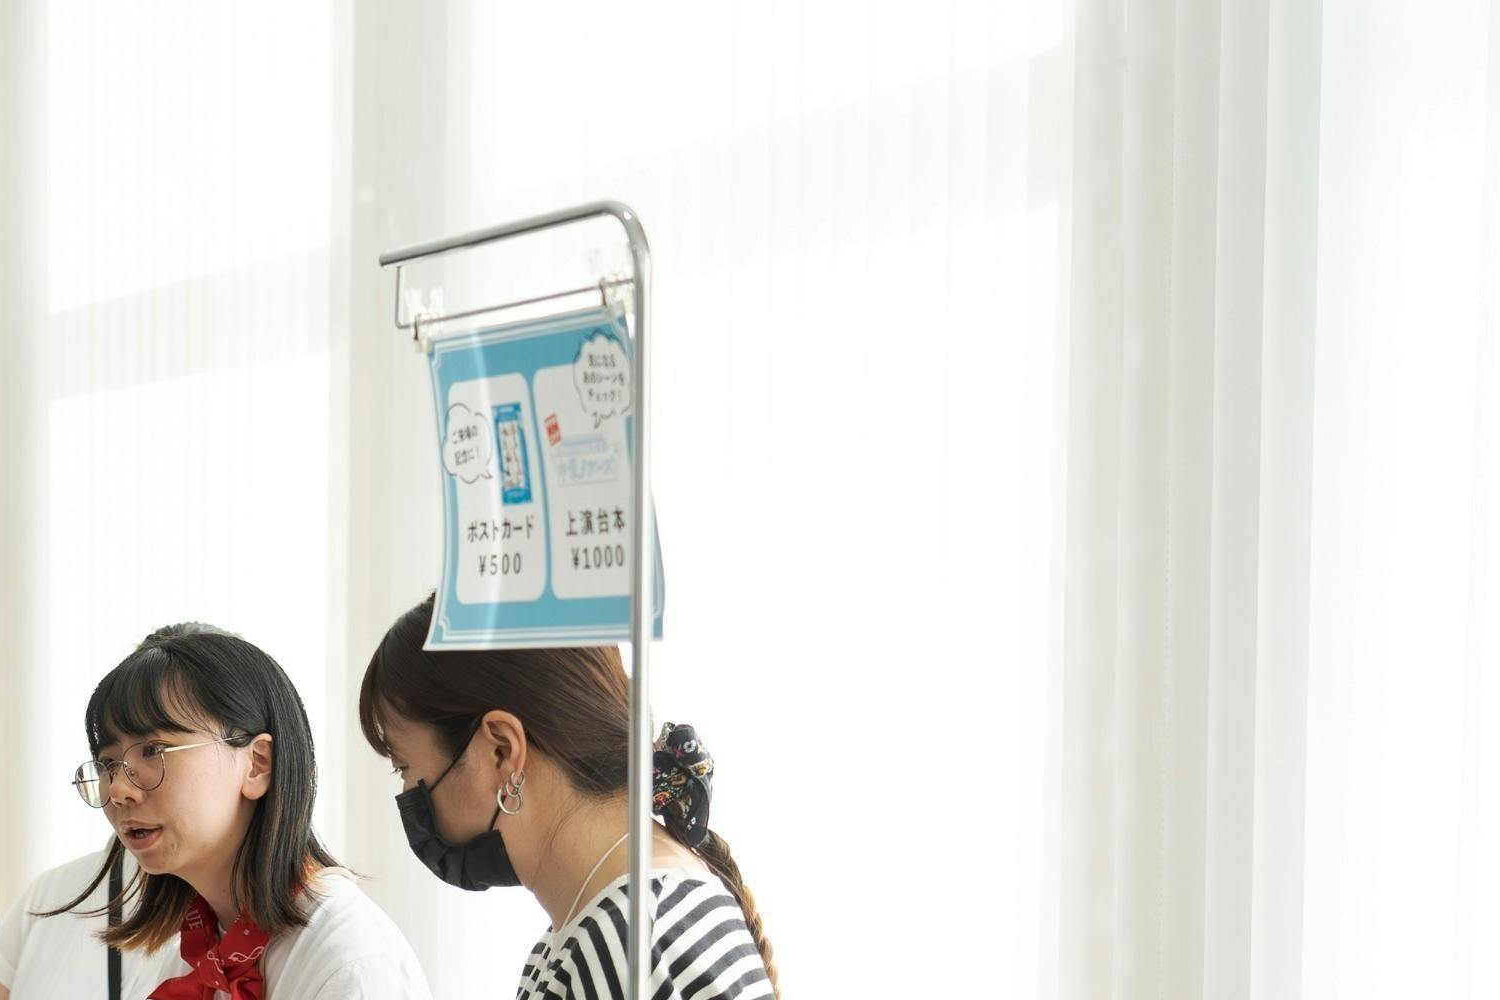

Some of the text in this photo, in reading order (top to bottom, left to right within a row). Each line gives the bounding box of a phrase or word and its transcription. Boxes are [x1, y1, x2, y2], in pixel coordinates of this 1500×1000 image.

[467, 514, 534, 543] ポストカード
[566, 506, 625, 537] 上演台本
[479, 552, 522, 576] ¥500
[571, 544, 624, 570] ¥1000
